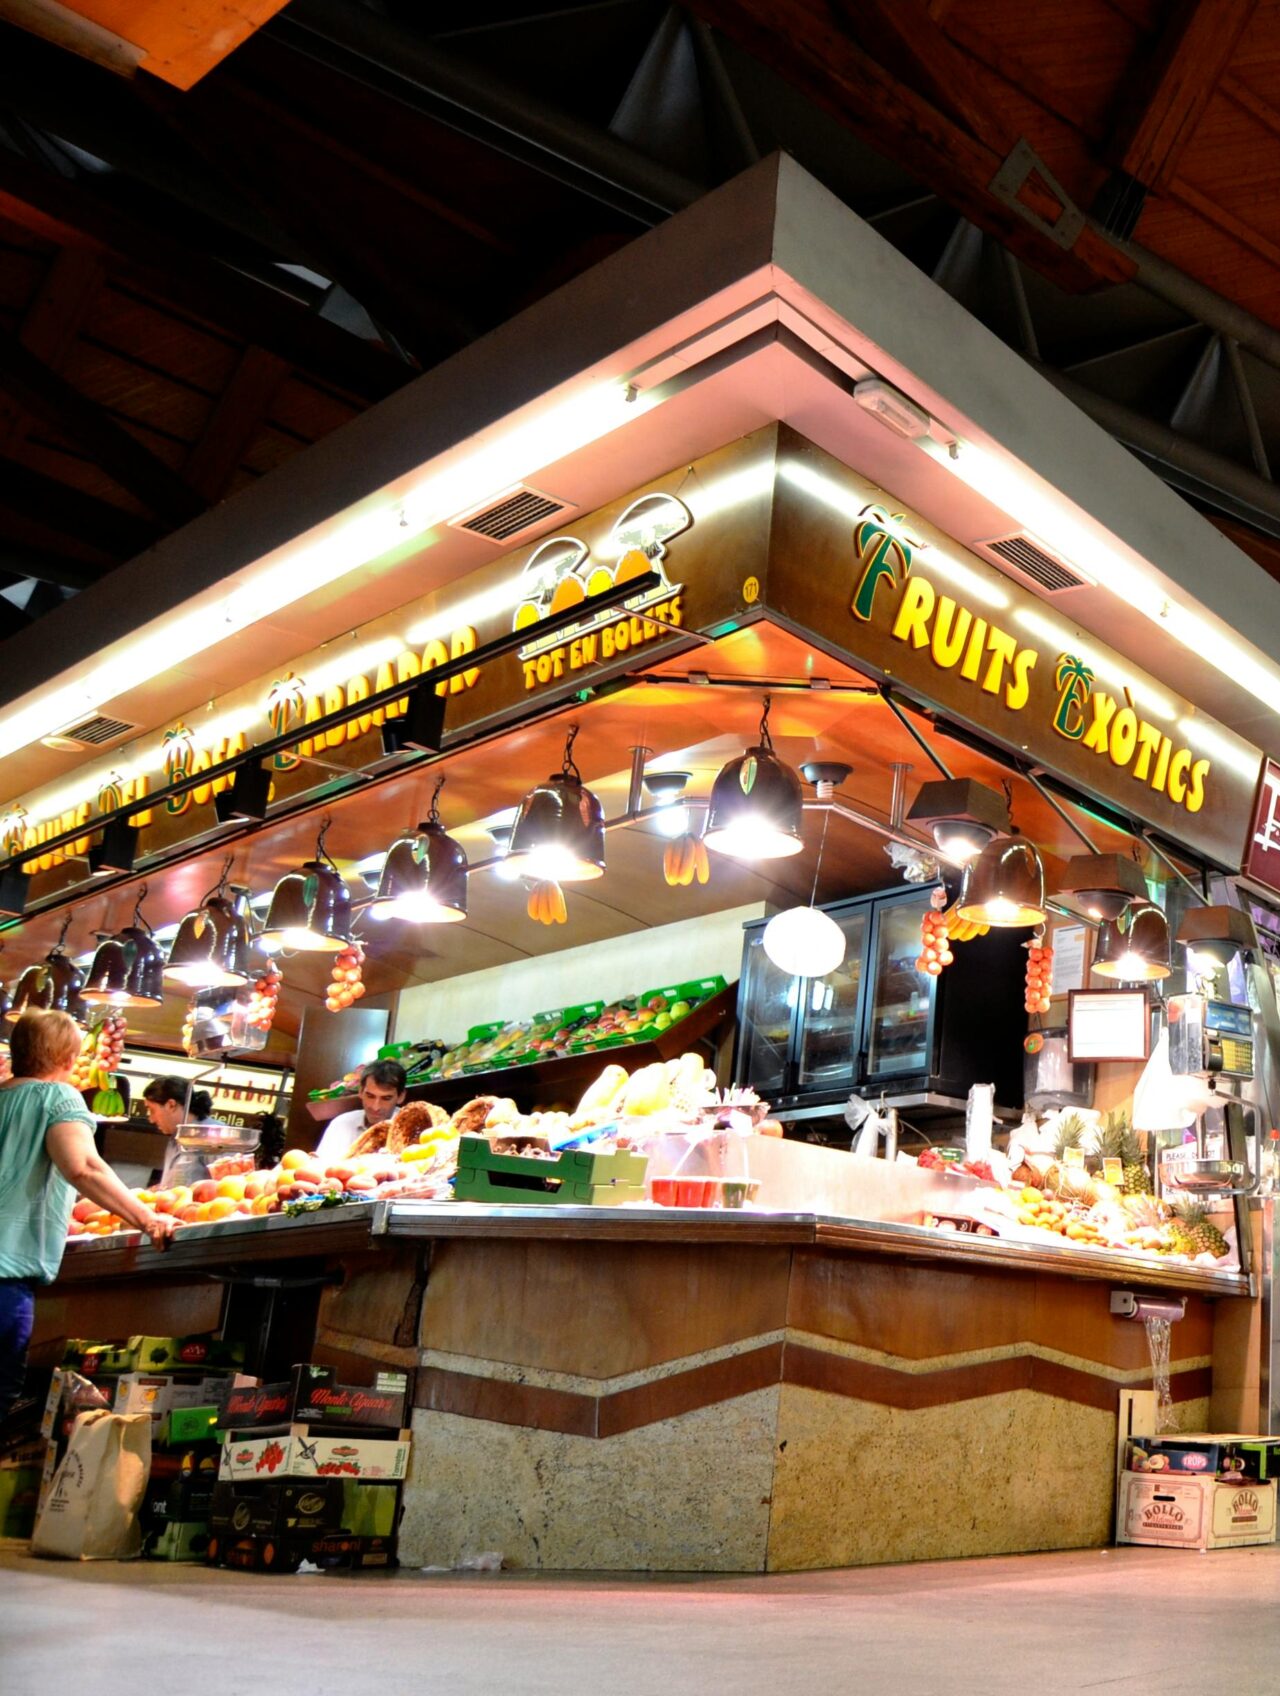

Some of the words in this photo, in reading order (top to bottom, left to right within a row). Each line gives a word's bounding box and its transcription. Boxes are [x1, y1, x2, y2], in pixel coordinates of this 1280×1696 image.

[522, 647, 565, 690] TOT
[570, 633, 600, 671] EN
[602, 597, 684, 658] BOLETS
[852, 503, 1038, 710] FRUITS
[1052, 652, 1211, 813] EXÒTICS
[1144, 1504, 1183, 1522] BOLLO
[1232, 1489, 1259, 1514] BOLLO
